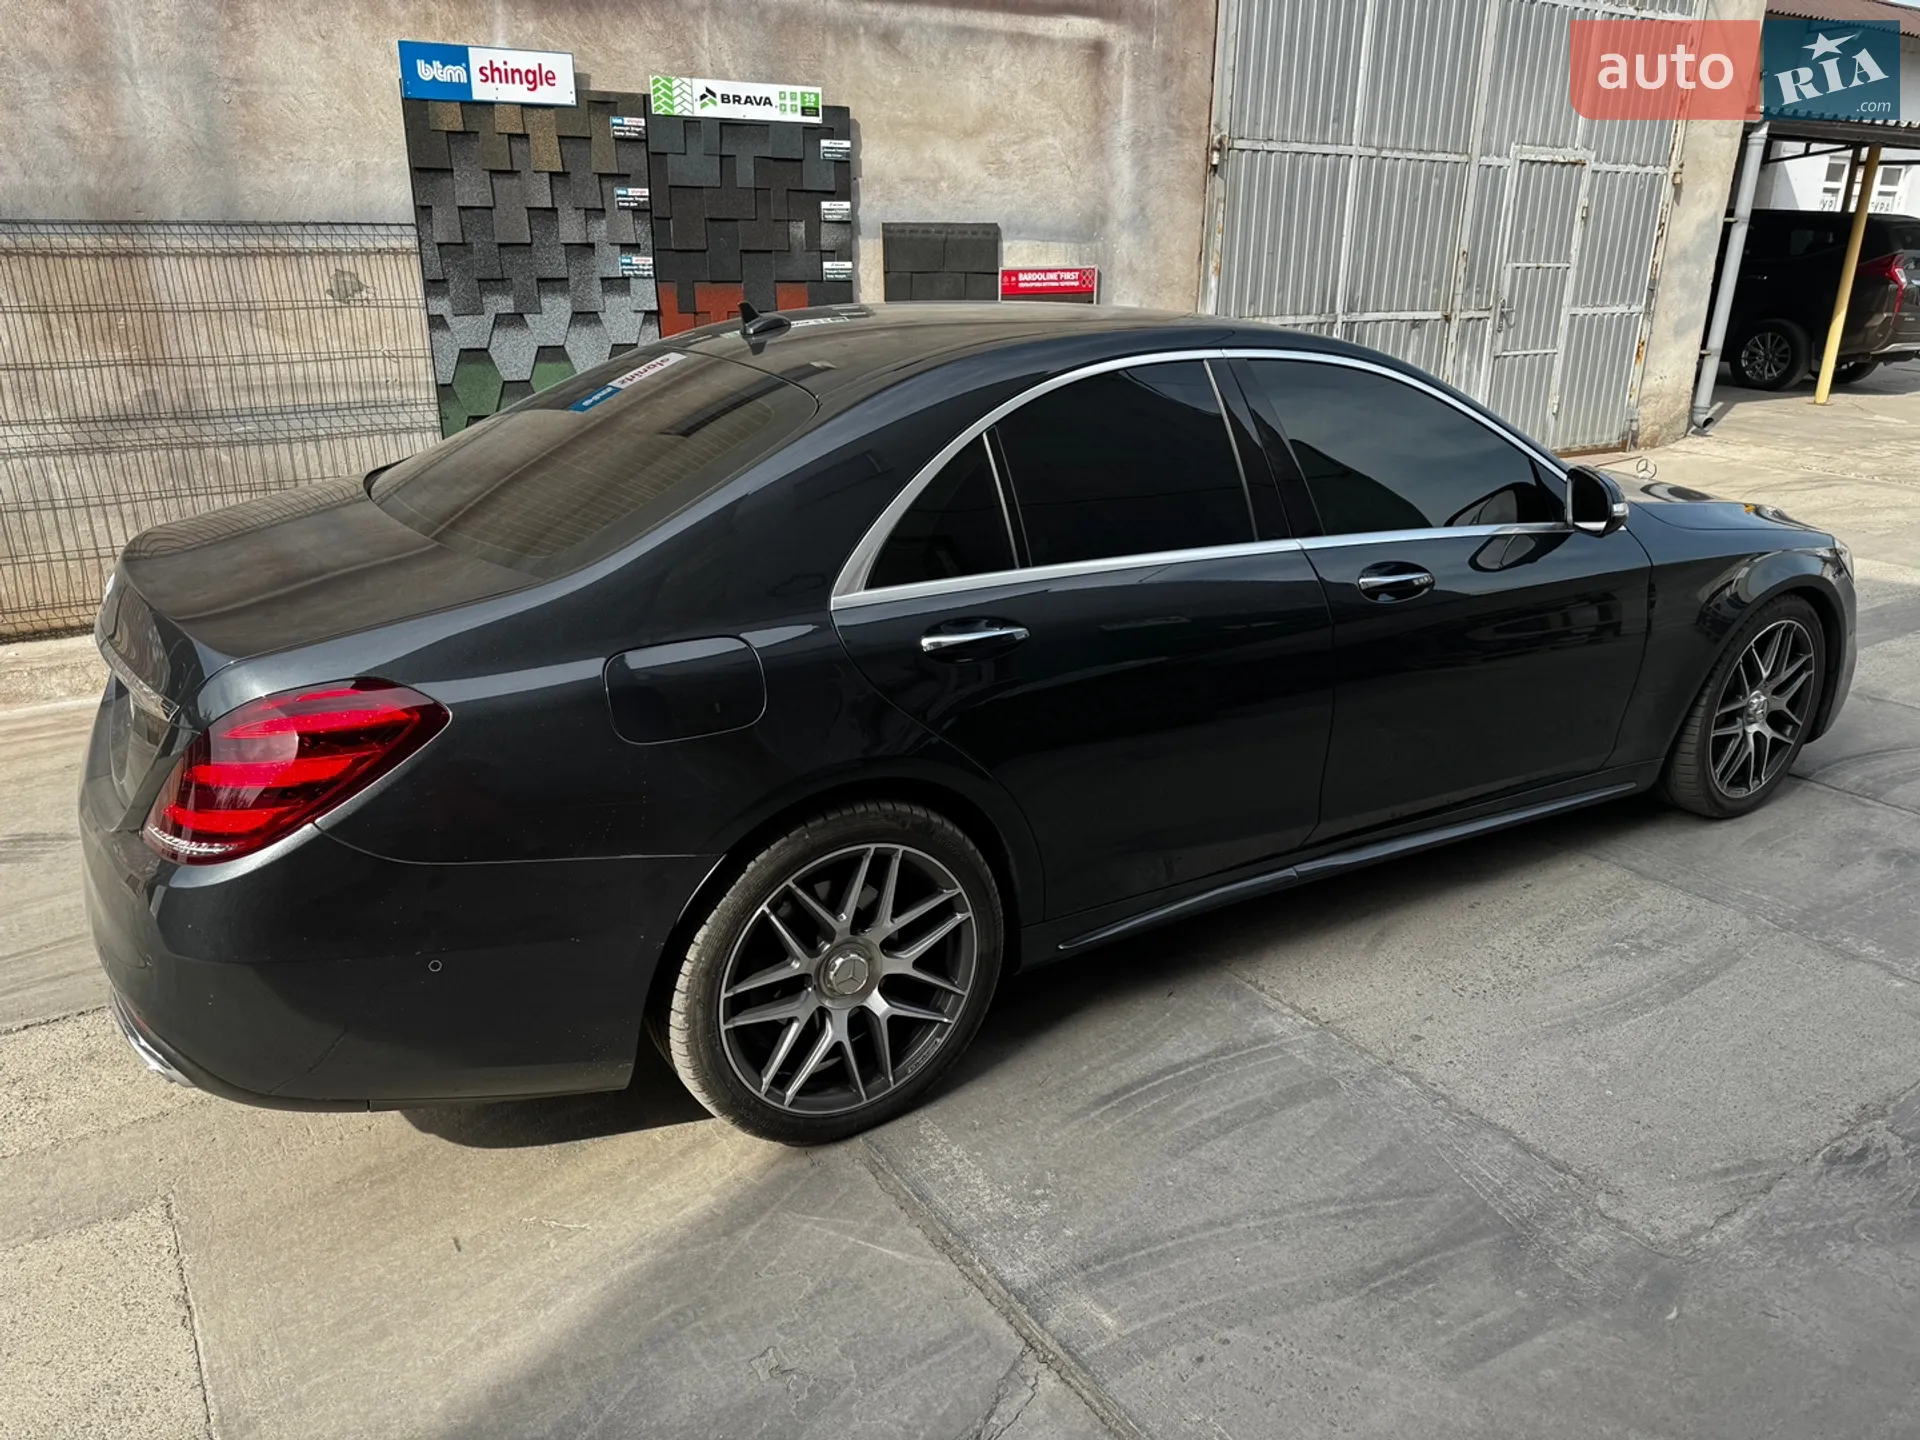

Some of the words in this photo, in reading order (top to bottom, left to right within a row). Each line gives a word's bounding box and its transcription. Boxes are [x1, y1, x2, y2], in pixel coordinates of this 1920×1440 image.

[416, 59, 467, 83] btm
[478, 60, 556, 92] shingle
[720, 93, 773, 107] BRAVA
[1018, 272, 1059, 281] BARDOLINE
[1060, 271, 1079, 280] FIRST
